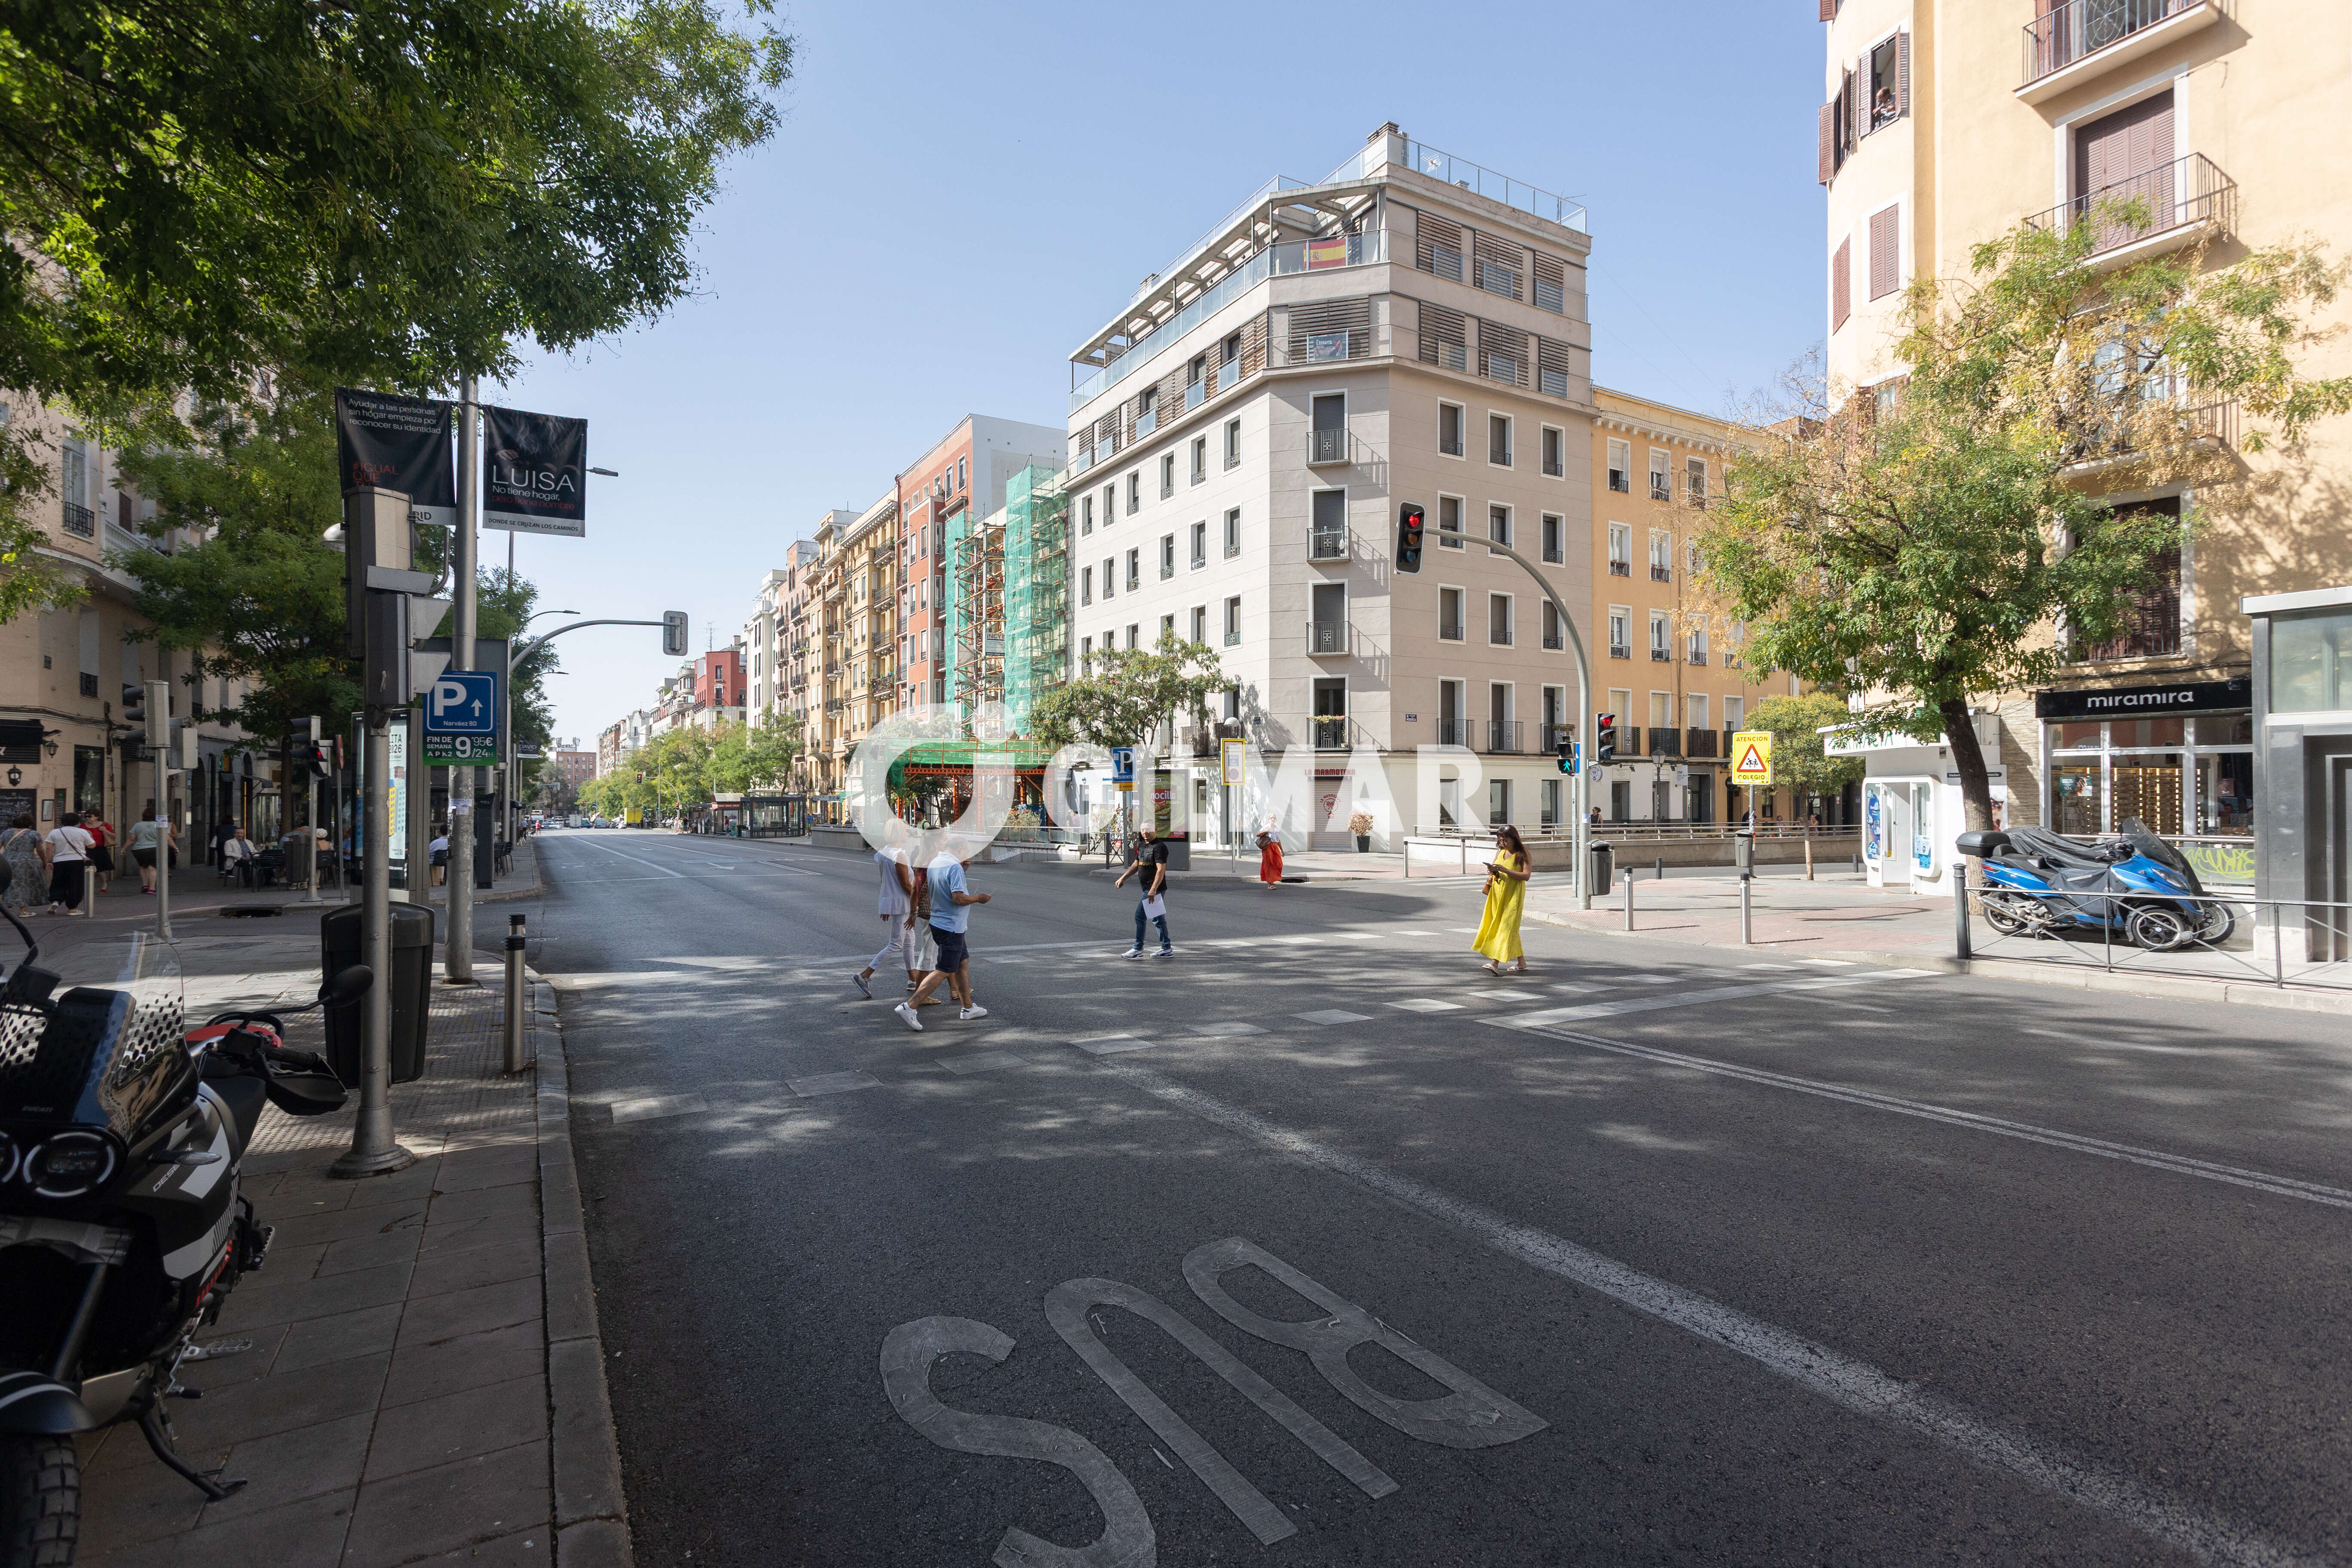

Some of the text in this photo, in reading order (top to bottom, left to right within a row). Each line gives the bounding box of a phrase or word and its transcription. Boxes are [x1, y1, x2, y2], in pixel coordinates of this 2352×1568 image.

[348, 398, 377, 408] Ayudar
[399, 407, 435, 416] personas
[362, 410, 386, 420] hogar
[388, 413, 422, 423] empieza
[349, 418, 392, 429] reconocer
[404, 424, 441, 434] identidad
[352, 462, 399, 475] #IGUAL
[353, 471, 380, 482] QUE
[493, 465, 575, 492] LUISA
[492, 485, 560, 501] No tiene hogar,
[514, 497, 537, 507] tiene
[539, 501, 575, 510] nombre
[434, 681, 467, 716] P
[2087, 691, 2194, 707] miramira
[1118, 751, 1134, 773] P
[1151, 790, 1176, 799] nocilla
[879, 1236, 1552, 1568] BUS
